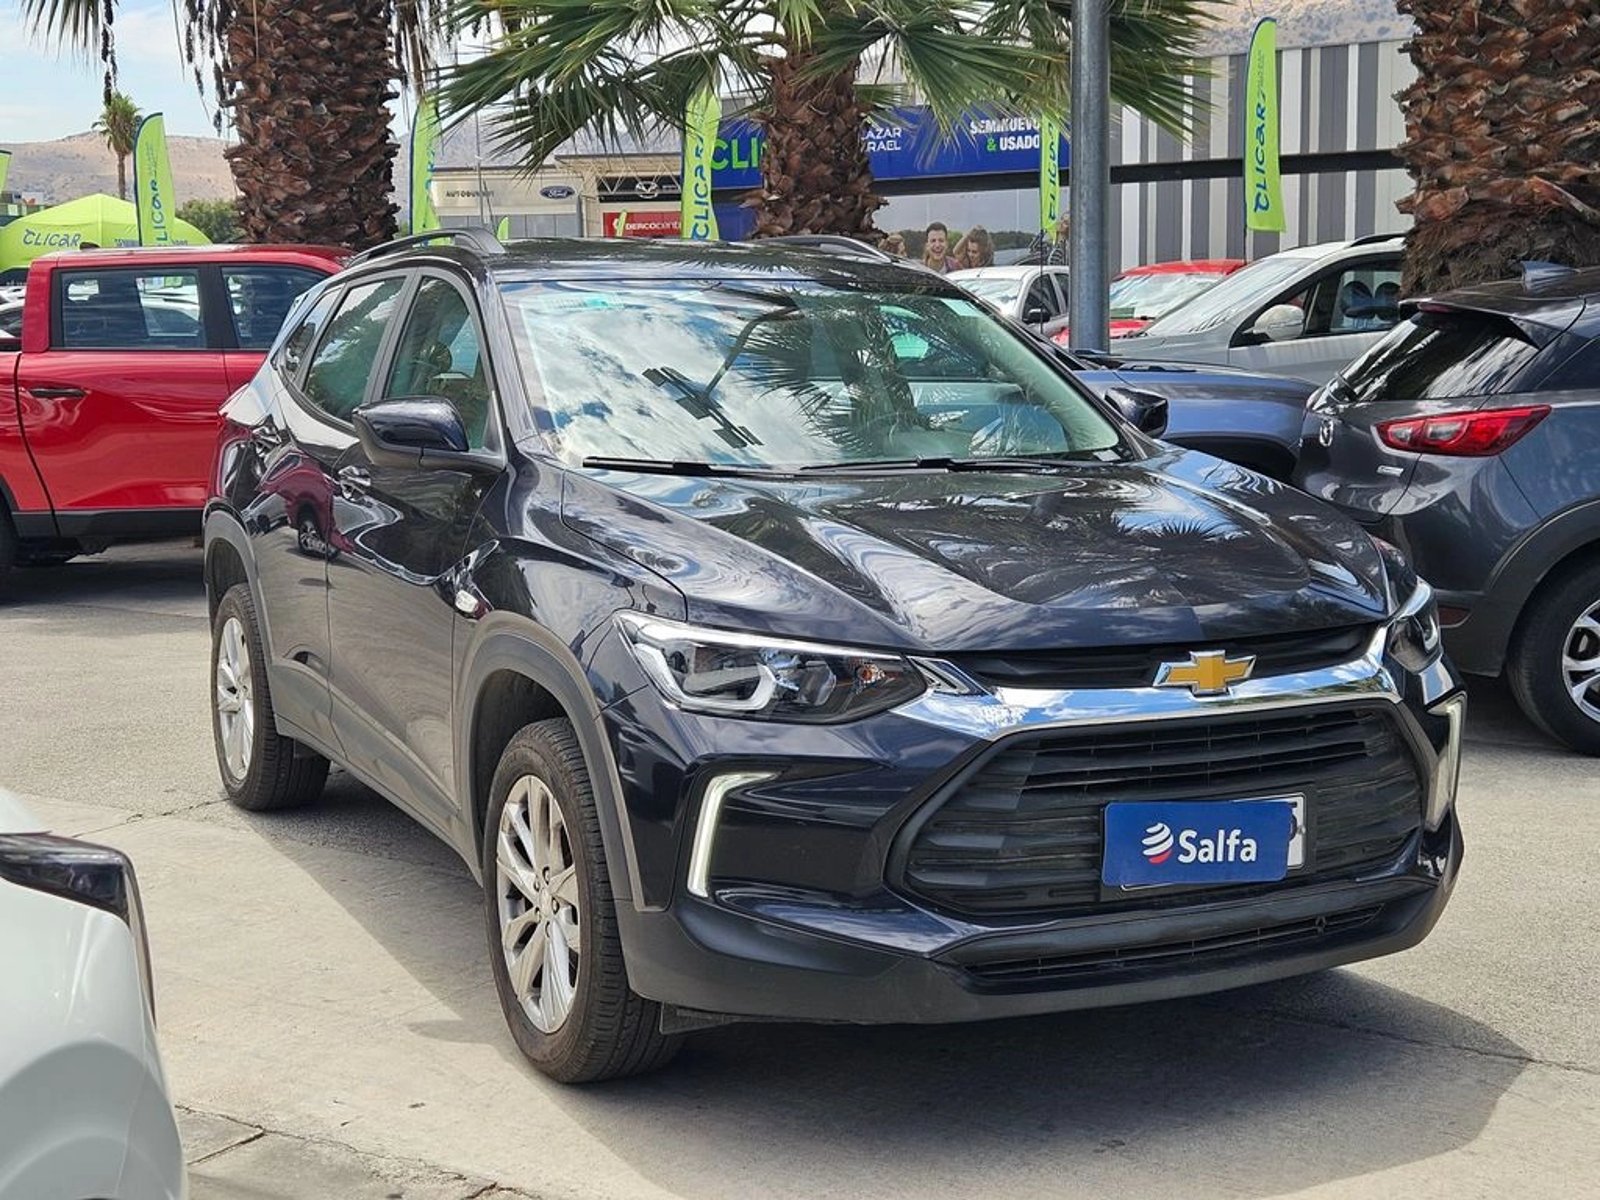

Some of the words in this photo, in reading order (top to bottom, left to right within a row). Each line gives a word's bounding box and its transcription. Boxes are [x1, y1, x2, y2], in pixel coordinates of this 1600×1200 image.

[970, 116, 1040, 134] SEMINUEVO
[999, 134, 1040, 151] USADO
[1177, 829, 1257, 864] Salfa
